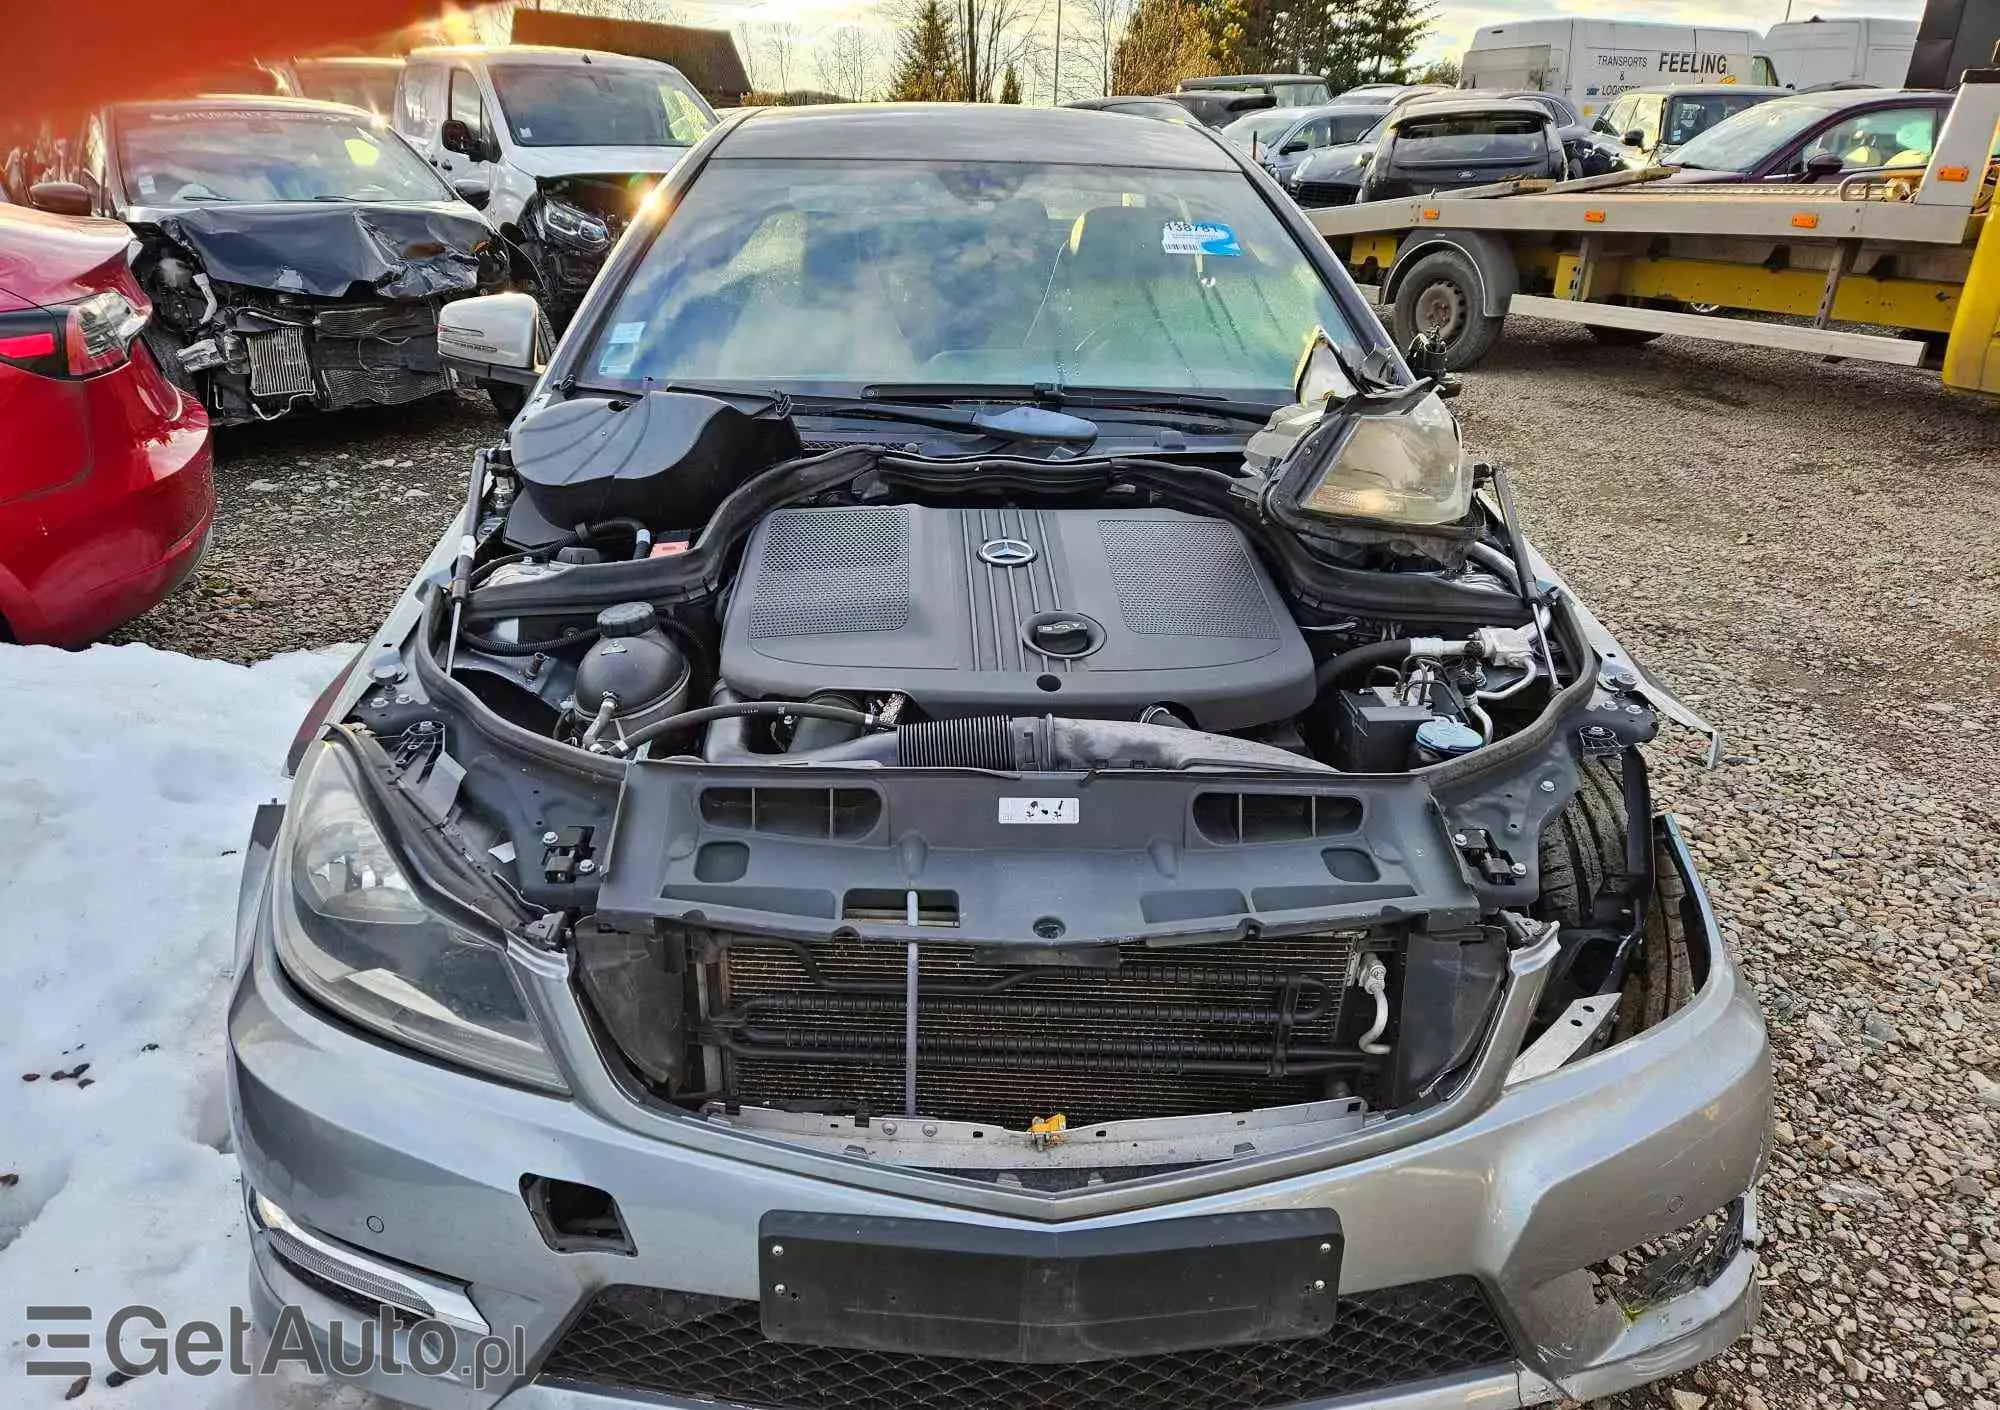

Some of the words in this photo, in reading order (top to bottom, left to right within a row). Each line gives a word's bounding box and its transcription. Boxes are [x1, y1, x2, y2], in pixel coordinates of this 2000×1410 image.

[1597, 55, 1648, 67] TRANSPORTS
[1658, 52, 1728, 75] FEELING
[1601, 84, 1641, 96] LOGIST
